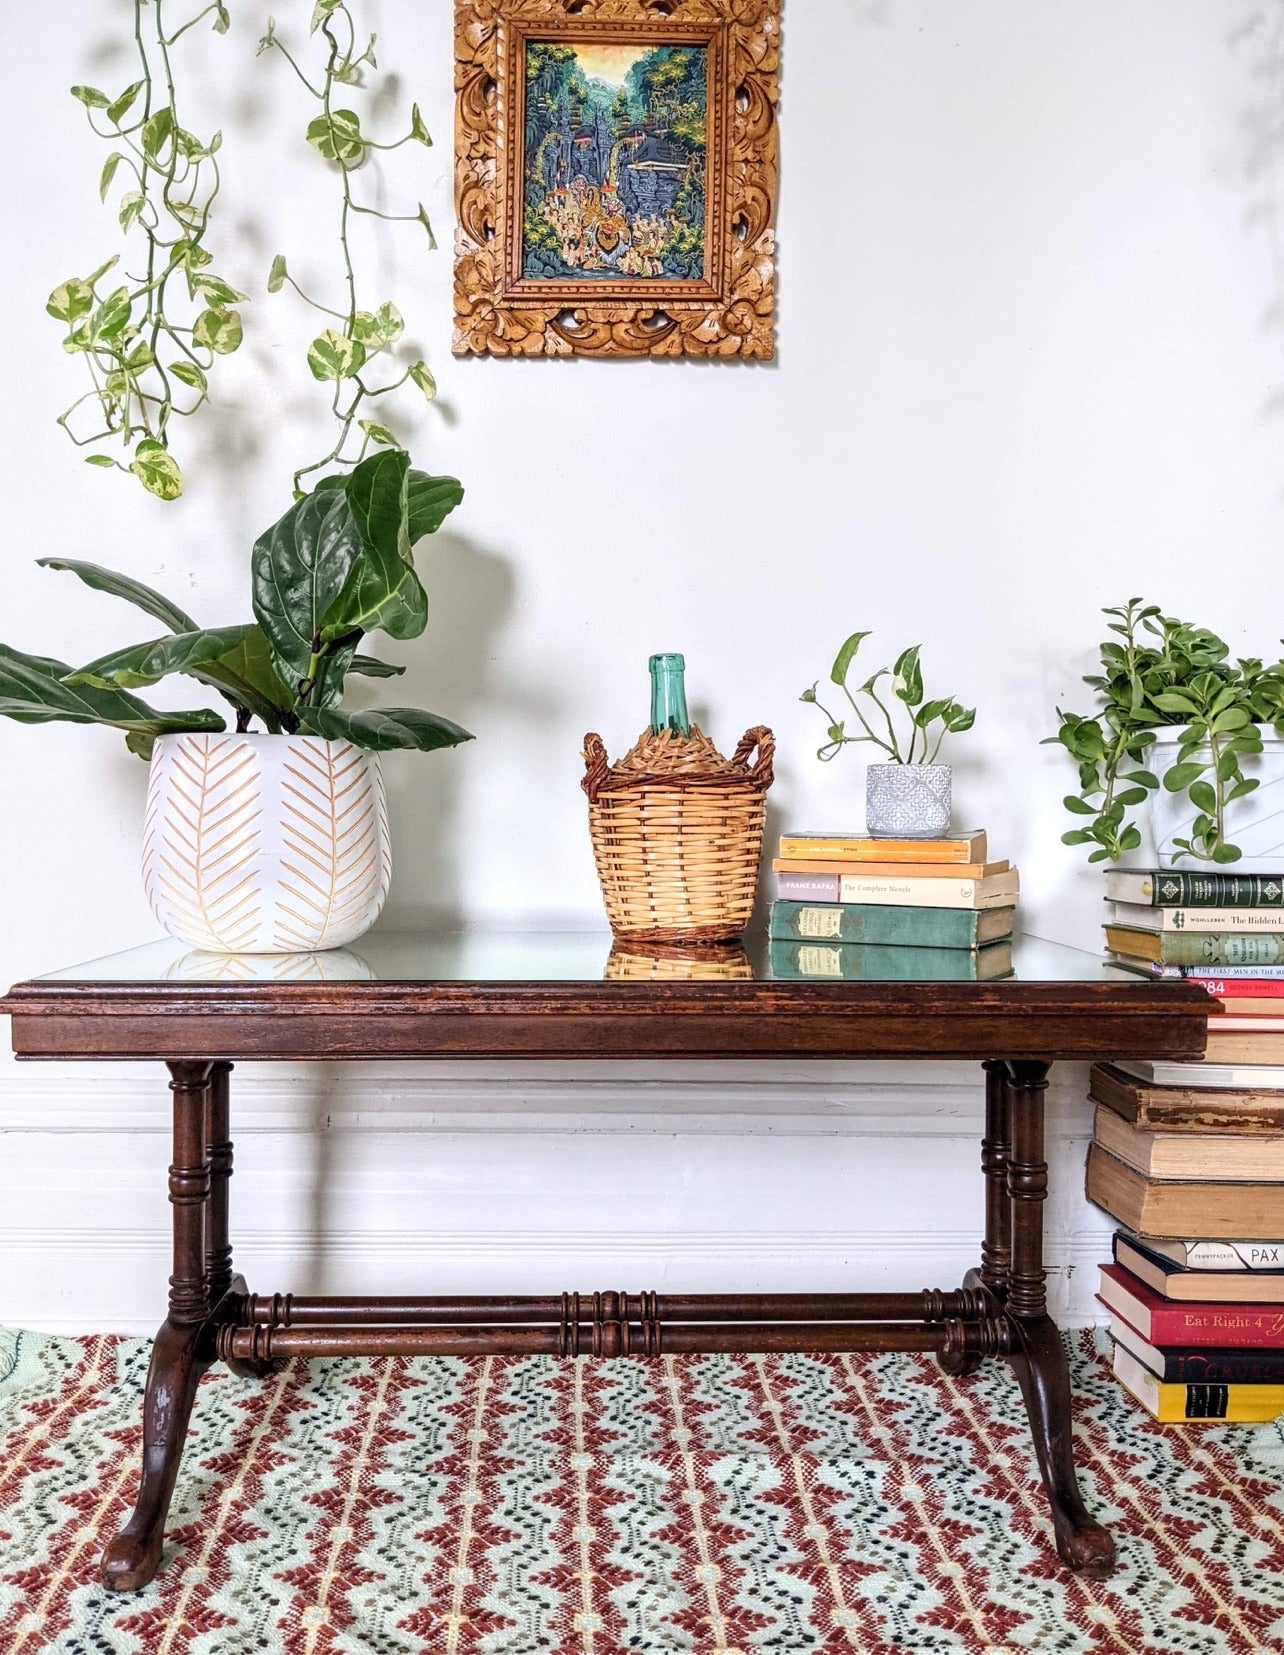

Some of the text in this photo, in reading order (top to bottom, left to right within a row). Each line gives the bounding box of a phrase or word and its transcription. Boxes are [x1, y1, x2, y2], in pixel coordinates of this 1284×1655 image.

[786, 882, 835, 891] FRANZ KAFKA
[844, 884, 911, 893] The Complete Novels
[1231, 916, 1247, 924] The
[1248, 916, 1277, 925] Hidden
[1213, 967, 1231, 975] FIRST
[1251, 1249, 1279, 1262] PAX
[1184, 1314, 1210, 1326] Eat
[1213, 1315, 1250, 1328] Right
[1254, 1317, 1263, 1328] 4
